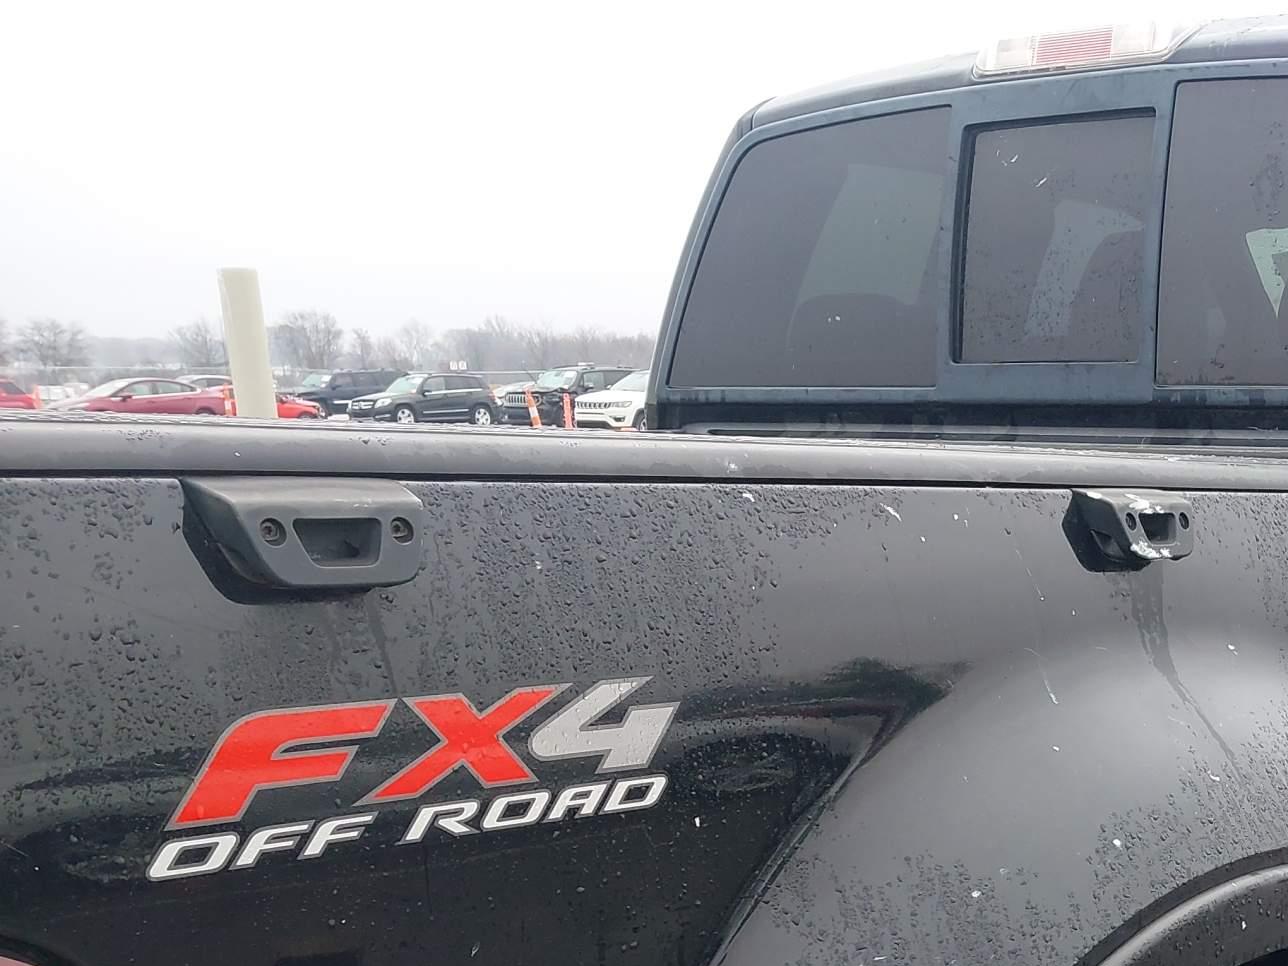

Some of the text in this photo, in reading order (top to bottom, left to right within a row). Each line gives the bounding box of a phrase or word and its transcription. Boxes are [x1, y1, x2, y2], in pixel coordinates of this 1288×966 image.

[165, 676, 681, 831] FX4
[145, 774, 669, 881] OFF ROAD
